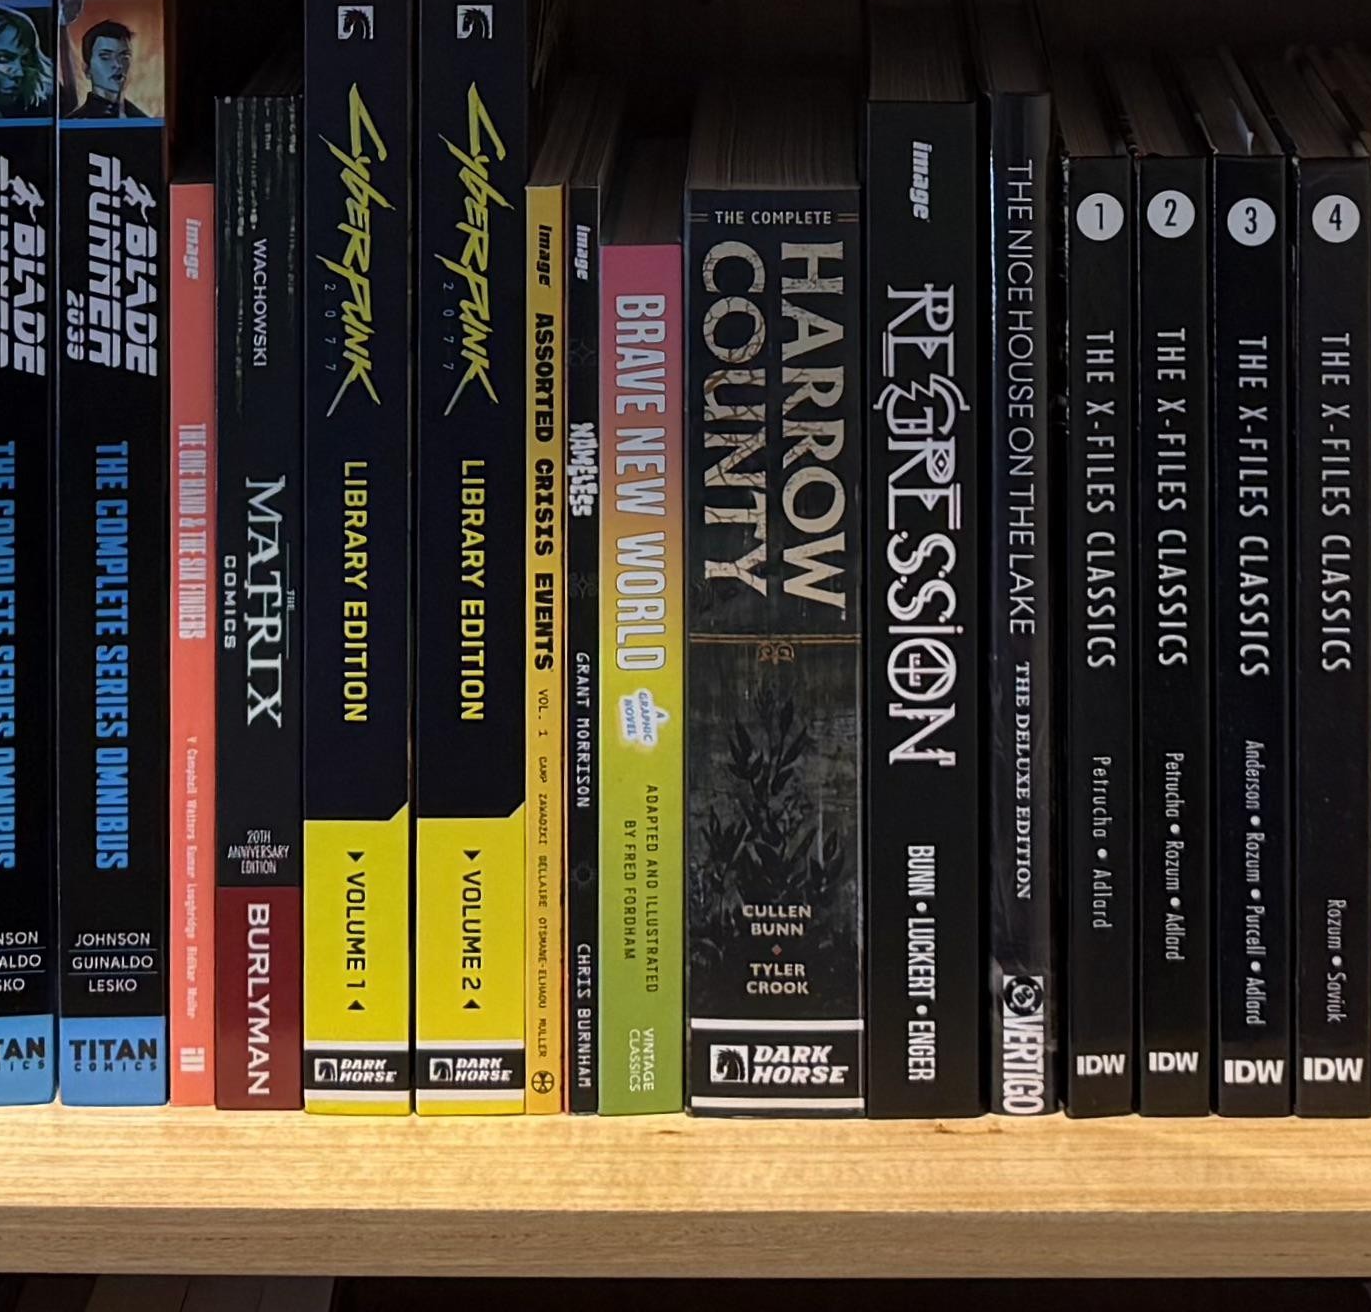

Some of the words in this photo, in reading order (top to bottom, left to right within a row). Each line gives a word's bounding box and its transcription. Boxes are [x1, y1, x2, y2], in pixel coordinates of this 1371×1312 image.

[1095, 202, 1104, 230] 1
[614, 294, 666, 416] BRAVE
[1085, 330, 1114, 389] THE
[614, 428, 666, 517] NEW
[702, 241, 766, 597] COUNTY
[779, 241, 848, 614] HARROW
[1085, 400, 1115, 516] X-FILES
[344, 462, 367, 589] LIBRARY
[617, 533, 666, 673] WORLD
[1086, 528, 1117, 670] CLASSICS
[344, 602, 367, 723] EDITION
[346, 872, 366, 972] VOLUME
[742, 905, 812, 919] CULLEN
[750, 922, 805, 937] BUNN
[245, 903, 270, 1096] BURLYMAN
[346, 979, 365, 988] 1
[1224, 1056, 1284, 1083] IDW
